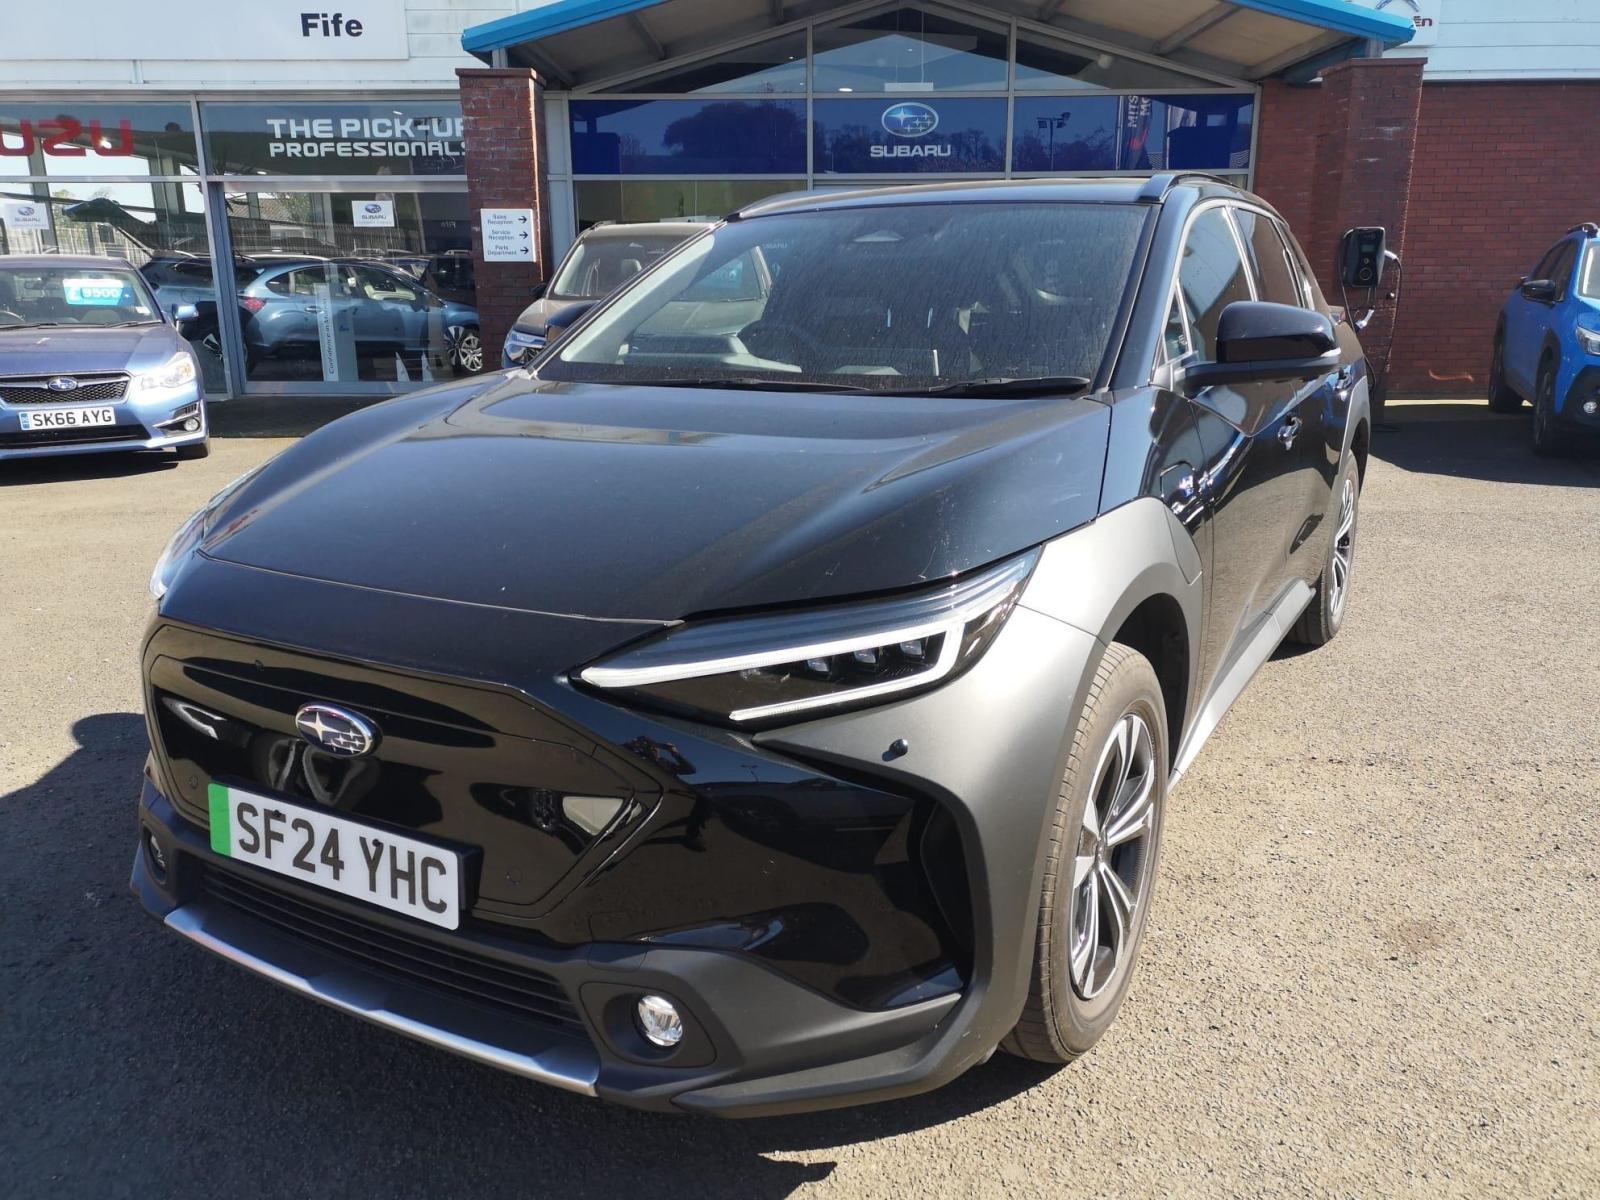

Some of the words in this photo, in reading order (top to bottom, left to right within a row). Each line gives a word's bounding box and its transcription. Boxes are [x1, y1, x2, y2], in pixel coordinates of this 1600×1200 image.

[300, 13, 363, 37] Fife
[266, 118, 334, 139] THE
[269, 141, 466, 158] PROFESSIONAL
[870, 144, 952, 158] SUBARU
[32, 411, 76, 427] SK66
[82, 409, 112, 424] AYG
[236, 801, 345, 882] SF24
[359, 835, 448, 914] YHC
